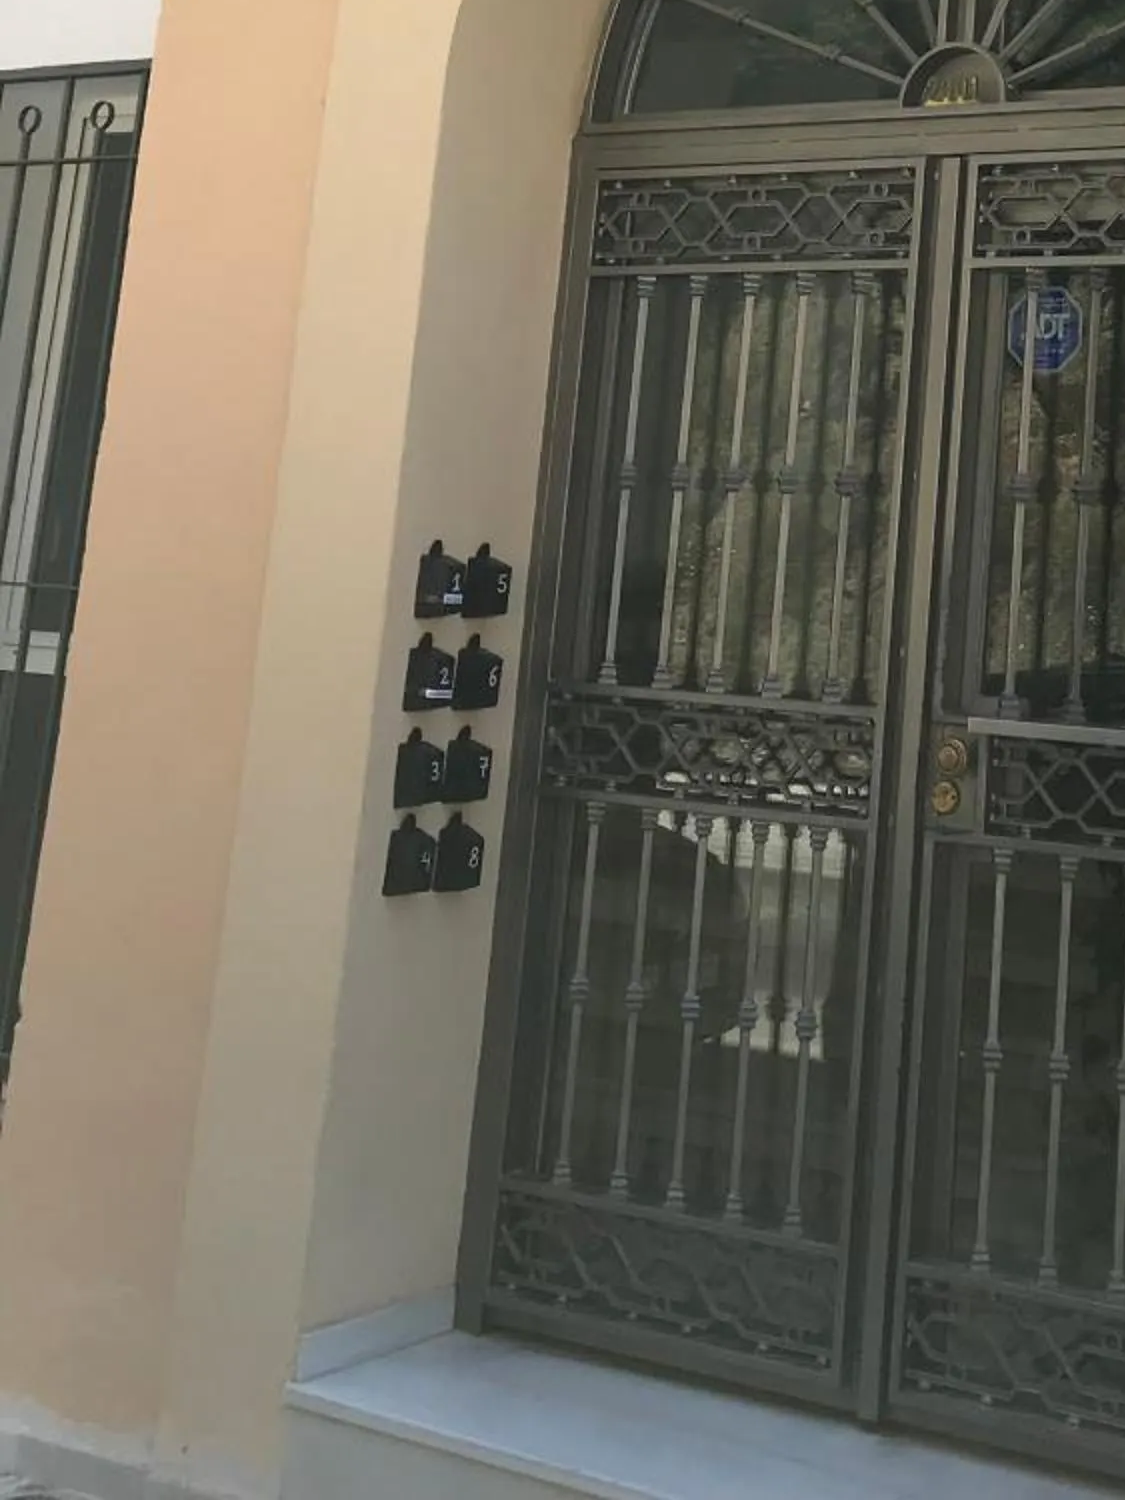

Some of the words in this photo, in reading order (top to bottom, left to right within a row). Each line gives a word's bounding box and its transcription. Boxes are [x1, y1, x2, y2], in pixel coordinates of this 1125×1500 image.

[452, 572, 461, 591] 1
[496, 573, 507, 593] 5
[440, 667, 449, 685] 2
[489, 665, 498, 687] 6
[431, 761, 439, 781] 3
[479, 757, 488, 778] 7
[421, 851, 431, 873] 4
[468, 846, 479, 868] 8
